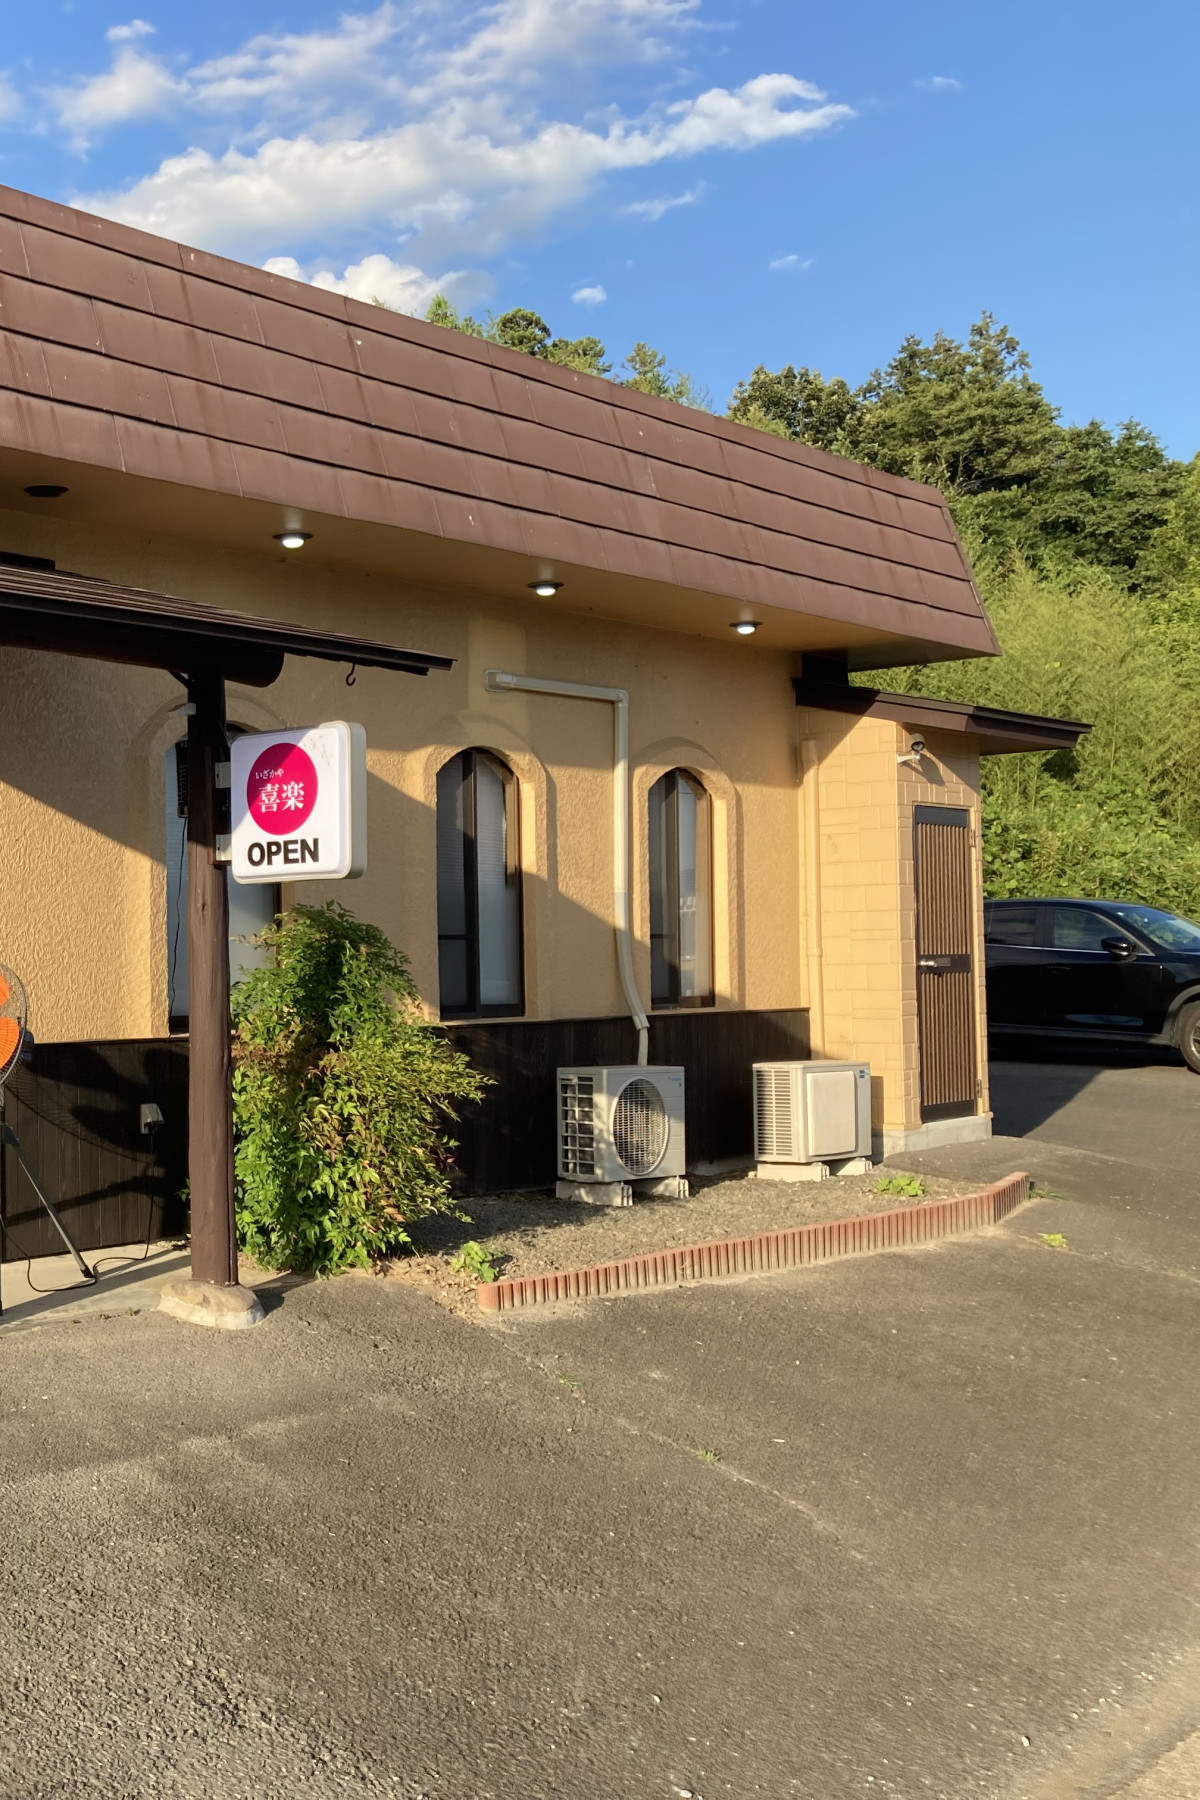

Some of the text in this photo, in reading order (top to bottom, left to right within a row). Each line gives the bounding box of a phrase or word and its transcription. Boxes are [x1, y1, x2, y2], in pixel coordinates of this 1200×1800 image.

[255, 768, 285, 780] いざかや
[258, 781, 305, 814] 喜楽
[247, 838, 320, 867] OPEN
